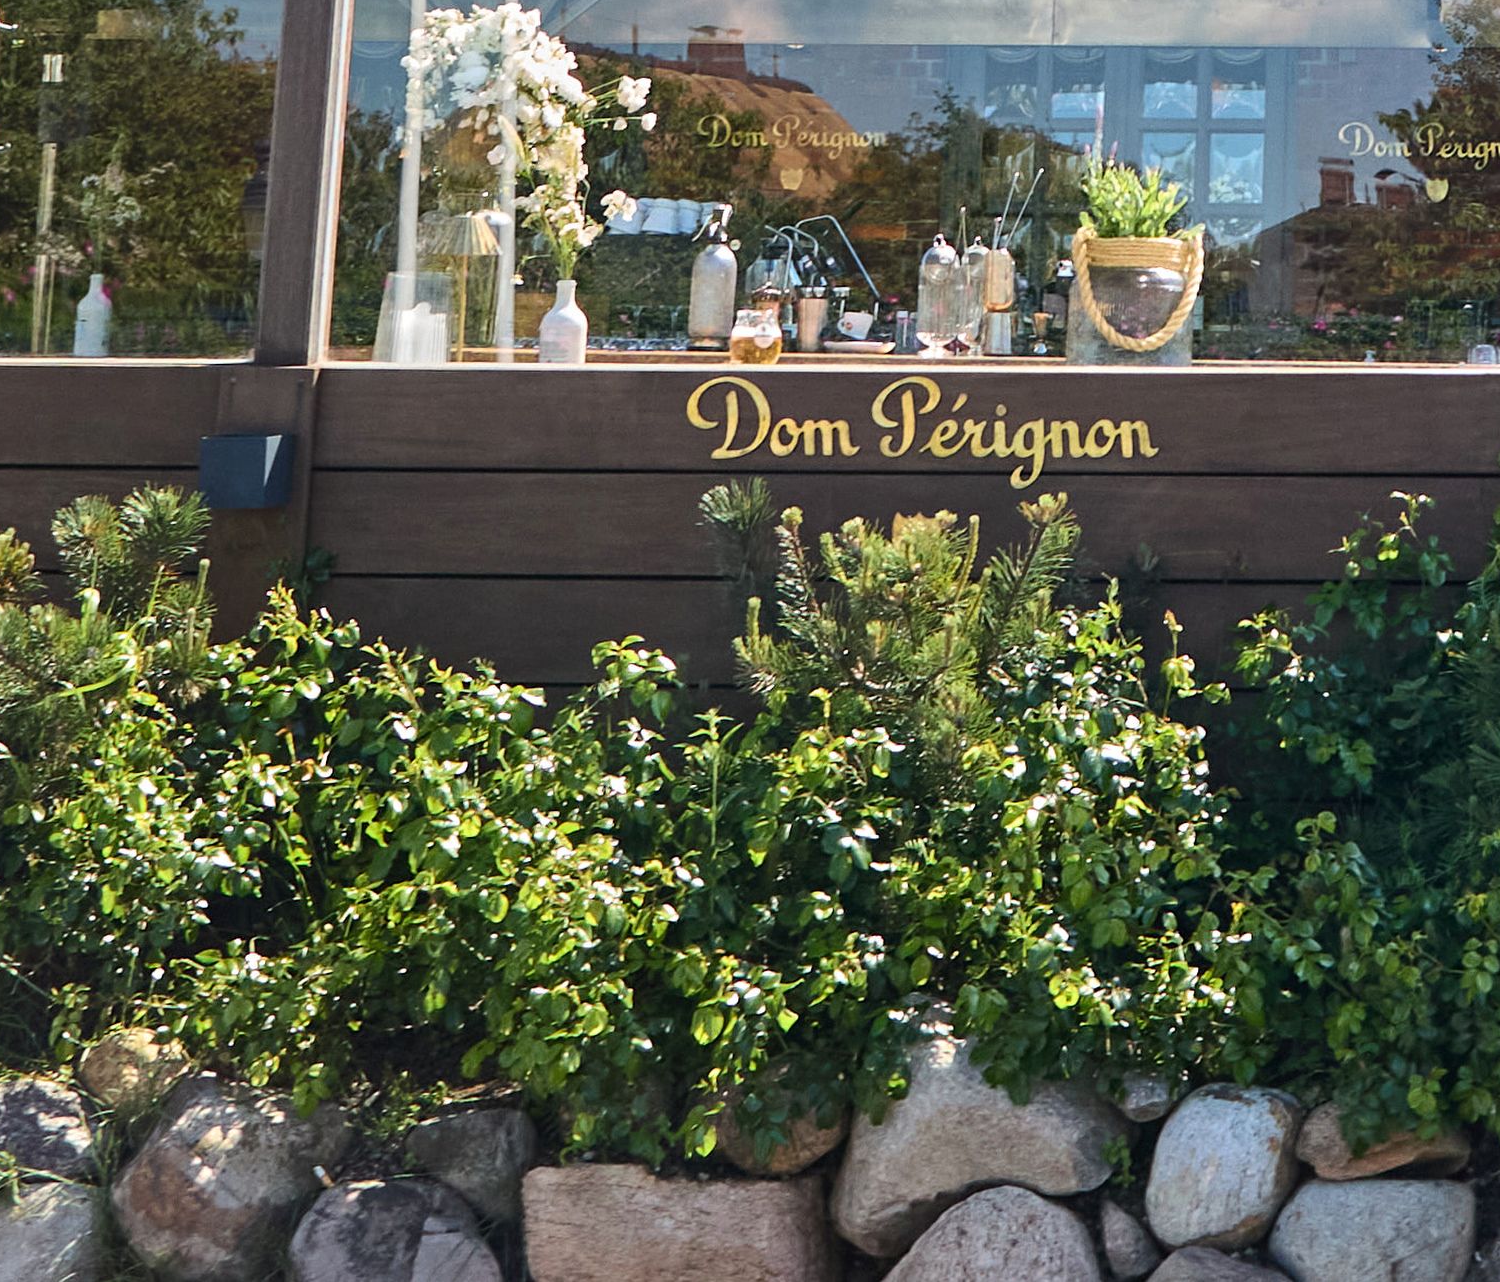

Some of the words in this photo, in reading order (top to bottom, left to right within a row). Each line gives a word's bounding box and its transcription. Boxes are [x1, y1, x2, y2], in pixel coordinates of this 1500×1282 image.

[697, 114, 770, 148] Dom
[772, 114, 889, 160] Pérignon
[1338, 121, 1412, 157] Dom
[686, 375, 861, 460] Dom
[871, 375, 1160, 490] Pérignon
